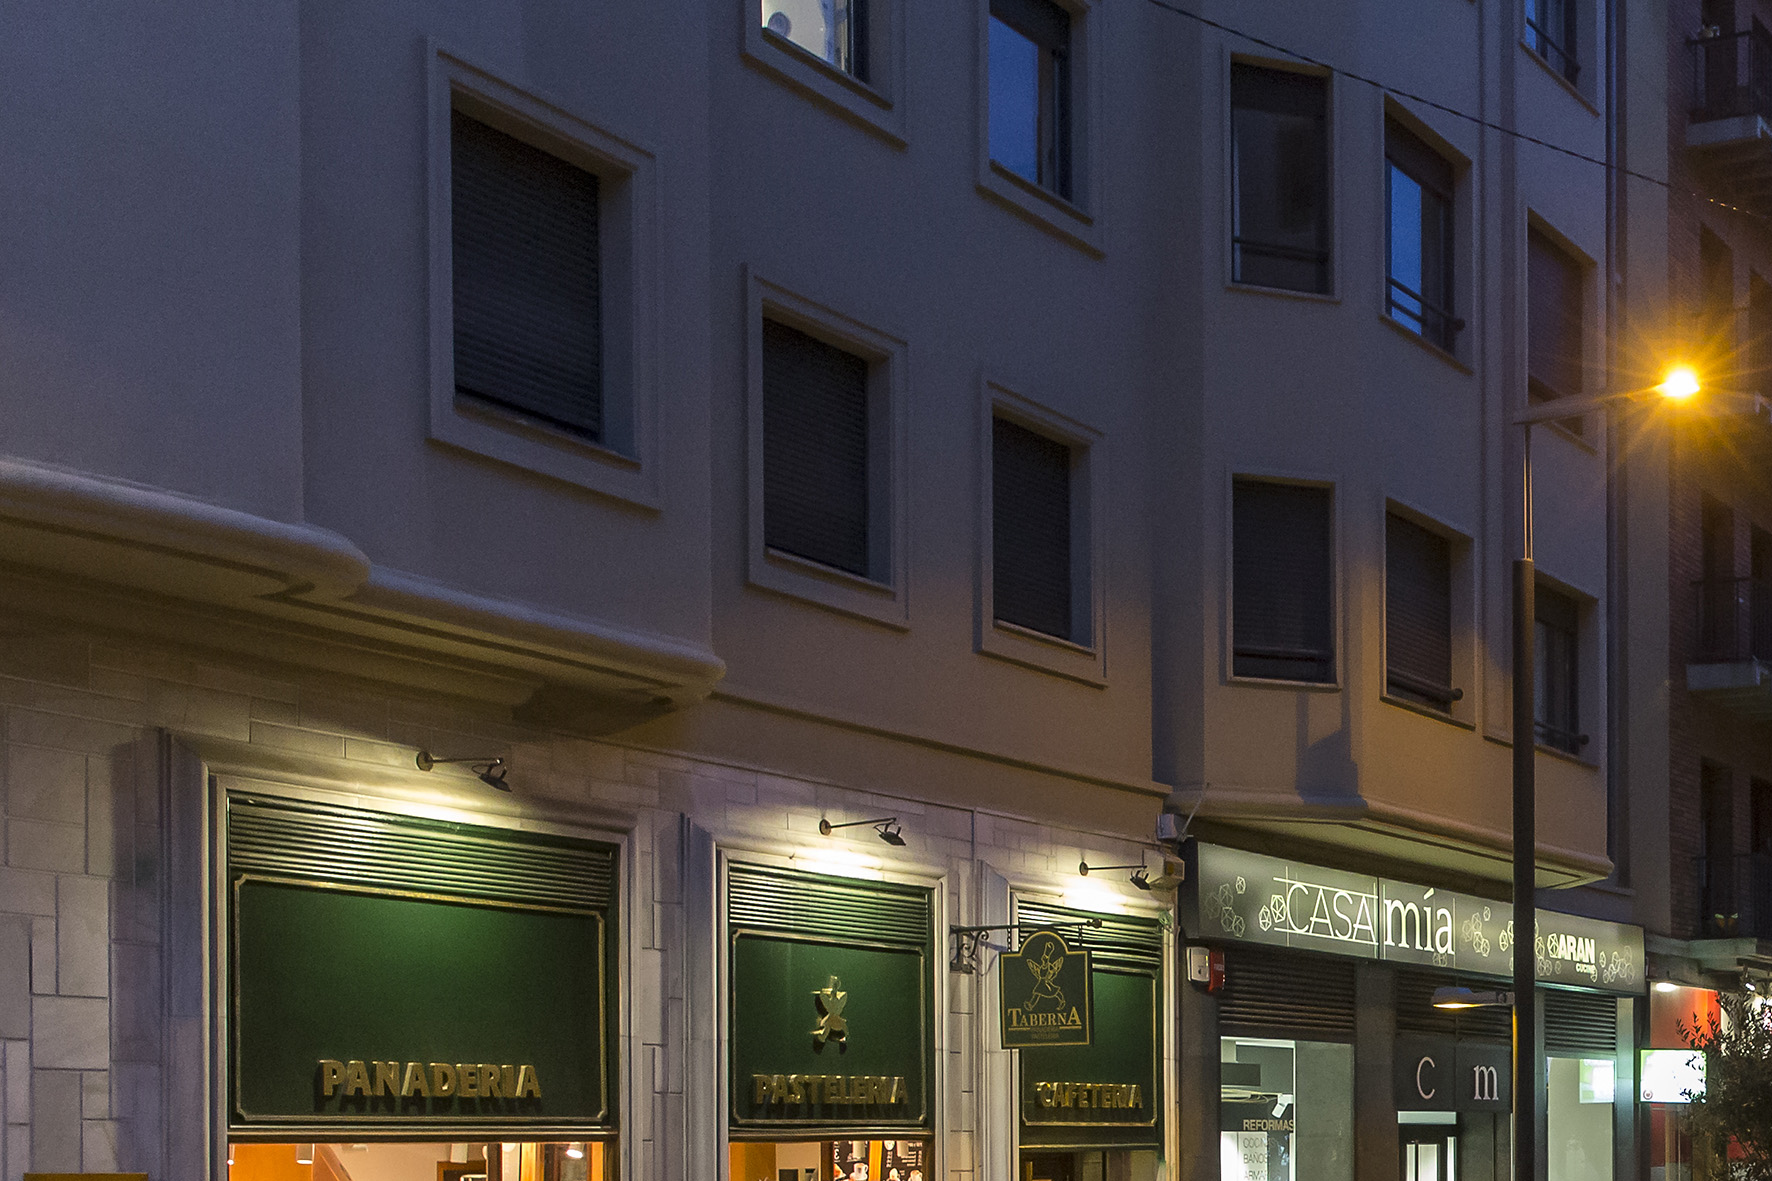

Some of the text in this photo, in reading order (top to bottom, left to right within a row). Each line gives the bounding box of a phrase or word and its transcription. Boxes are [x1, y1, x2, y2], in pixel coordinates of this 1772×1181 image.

[1286, 883, 1455, 955] CASA mía
[1559, 934, 1595, 963] ARAN
[1008, 1006, 1082, 1027] TABERNA
[318, 1060, 542, 1098] PANADERIA
[752, 1074, 909, 1104] PASTELERIA
[1036, 1082, 1142, 1108] CAFETERIA
[1243, 1119, 1294, 1131] REFORMAS
